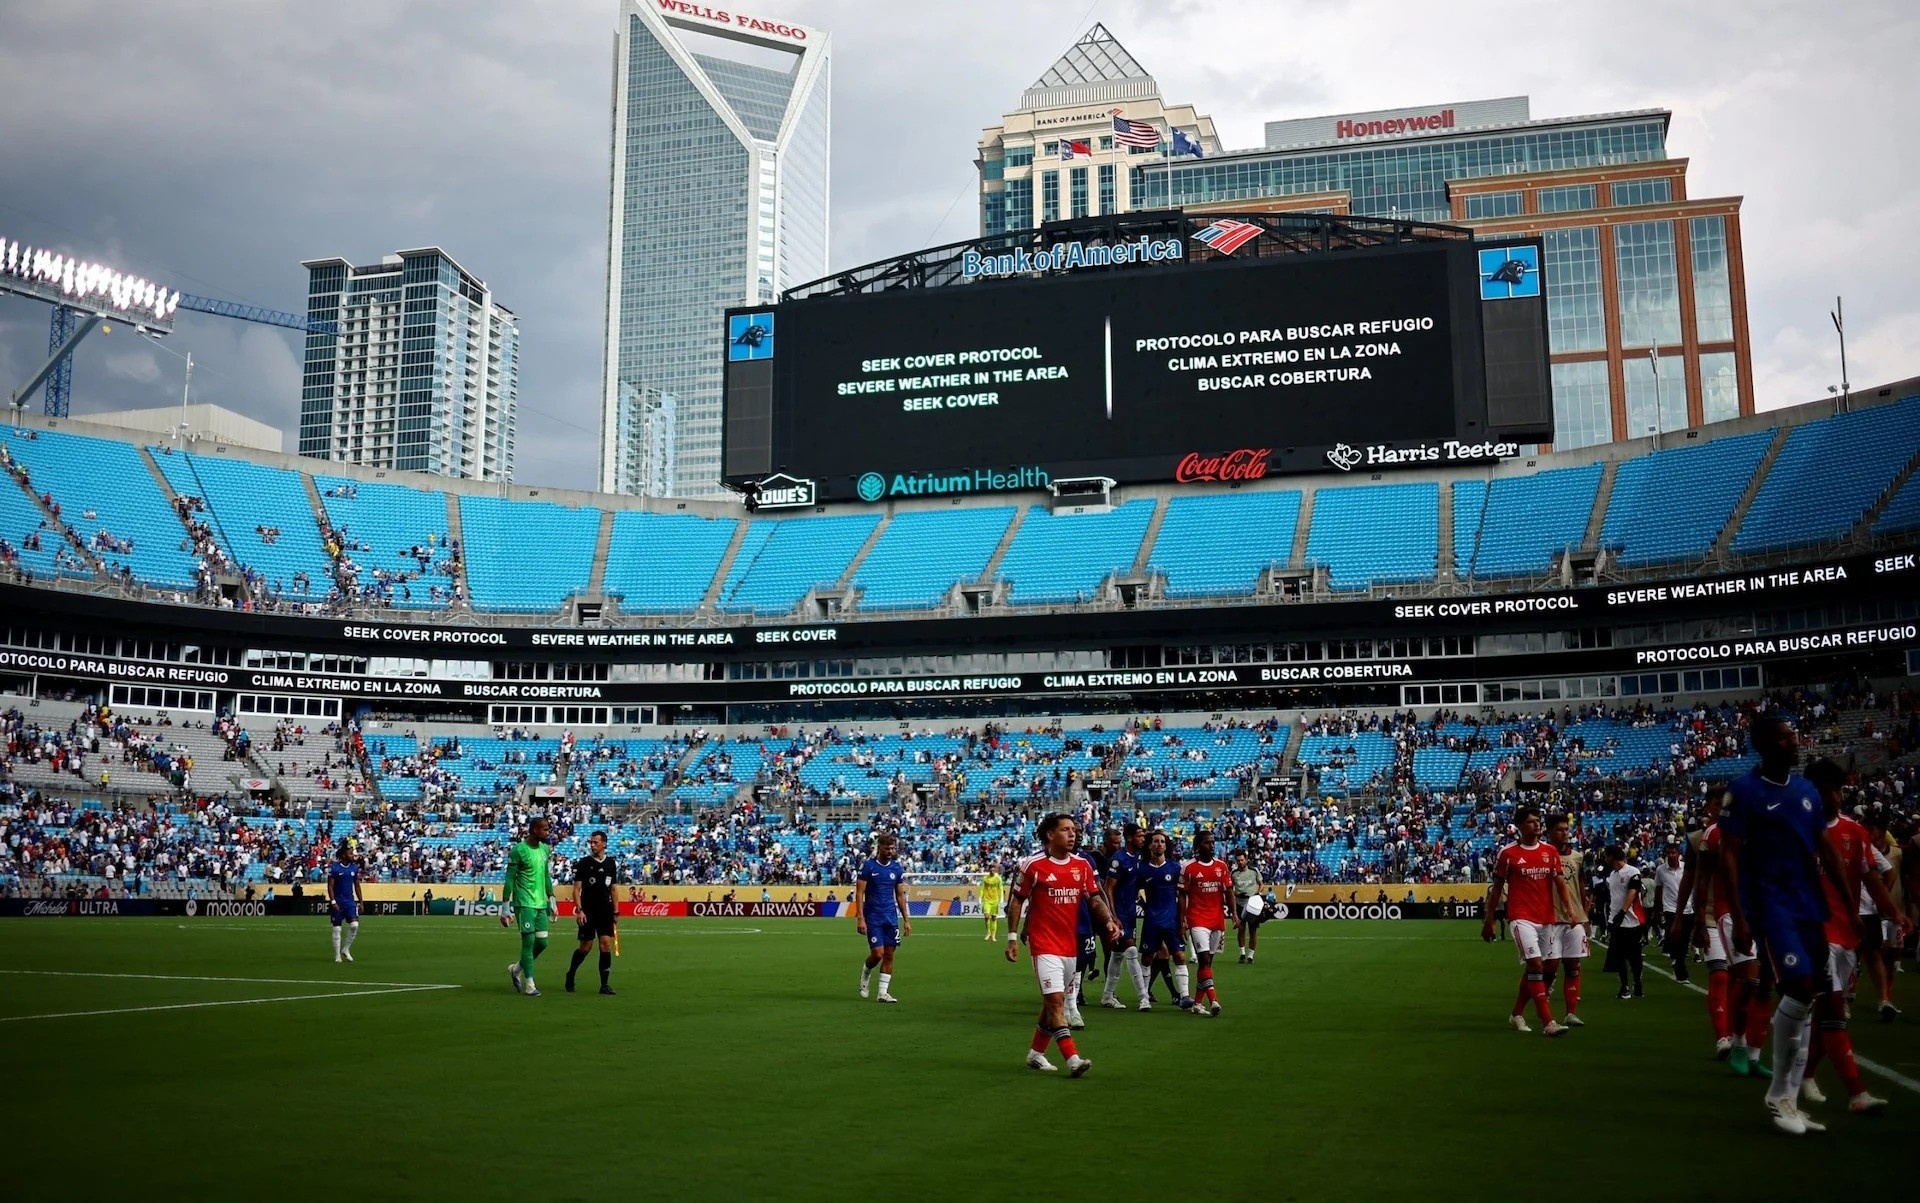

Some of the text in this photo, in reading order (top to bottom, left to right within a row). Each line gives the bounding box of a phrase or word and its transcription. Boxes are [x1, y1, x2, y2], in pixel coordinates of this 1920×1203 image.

[657, 0, 807, 41] WELLS FARGO
[1036, 112, 1106, 126] BANK OF AMERICA
[1337, 109, 1455, 139] Honeywell
[1065, 235, 1183, 268] America
[1136, 317, 1433, 351] PROTOCOLO PARA BUSCAR REFUGIO
[862, 347, 1042, 372] SEEK COVER PROTOCOL
[1168, 343, 1401, 371] CLIMA EXTREMO EN LA ZONA
[838, 366, 1068, 395] SEVERE WEATHER IN THE AREA
[1198, 367, 1371, 391] BUSCAR COBERTURA
[903, 393, 998, 411] SEEK COVER
[1367, 441, 1518, 464] Harris Teeter
[1175, 448, 1272, 483] Coca-Cola
[890, 466, 1049, 496] Atrium Health
[1875, 555, 1915, 572] SEEK
[1608, 567, 1847, 604] SEVERE WEATHER IN THE AREA
[1395, 597, 1578, 617] SEEK COVER PROTOCOL
[344, 627, 507, 644] SEEK COVER PROTOCOL
[532, 633, 733, 645] SEVERE WEATHER IN THE AREA
[756, 629, 836, 642] SEEK COVER
[1637, 626, 1916, 663] PROTOCOLO PARA BUSCAR REFUGIO
[70, 660, 105, 673] PARA
[109, 664, 165, 678] BUSCAR
[169, 669, 228, 683] REFUGIO
[1044, 670, 1237, 687] CLIMA EXTREMO EN LA ZONA
[1262, 664, 1412, 680] BUSCAR COBERTURA
[252, 675, 441, 694] CLIMA EXTREMO EN LA ZONA
[464, 685, 601, 697] BUSCAR COBERTURA
[790, 677, 1021, 695] PROTOCOLO PARA BUSCAR REFUGIO
[1048, 886, 1080, 896] Emirate
[24, 900, 119, 916] Michelob ULTRA
[206, 900, 266, 916] motorola
[316, 902, 330, 913] PIF
[382, 902, 398, 913] PIF
[453, 901, 515, 916] Hise
[634, 903, 670, 916] Coca-Cola
[693, 903, 816, 916] QATAR AIRWAYS
[1304, 903, 1402, 920] motorola
[1455, 905, 1478, 917] PIF
[1084, 936, 1096, 949] 25
